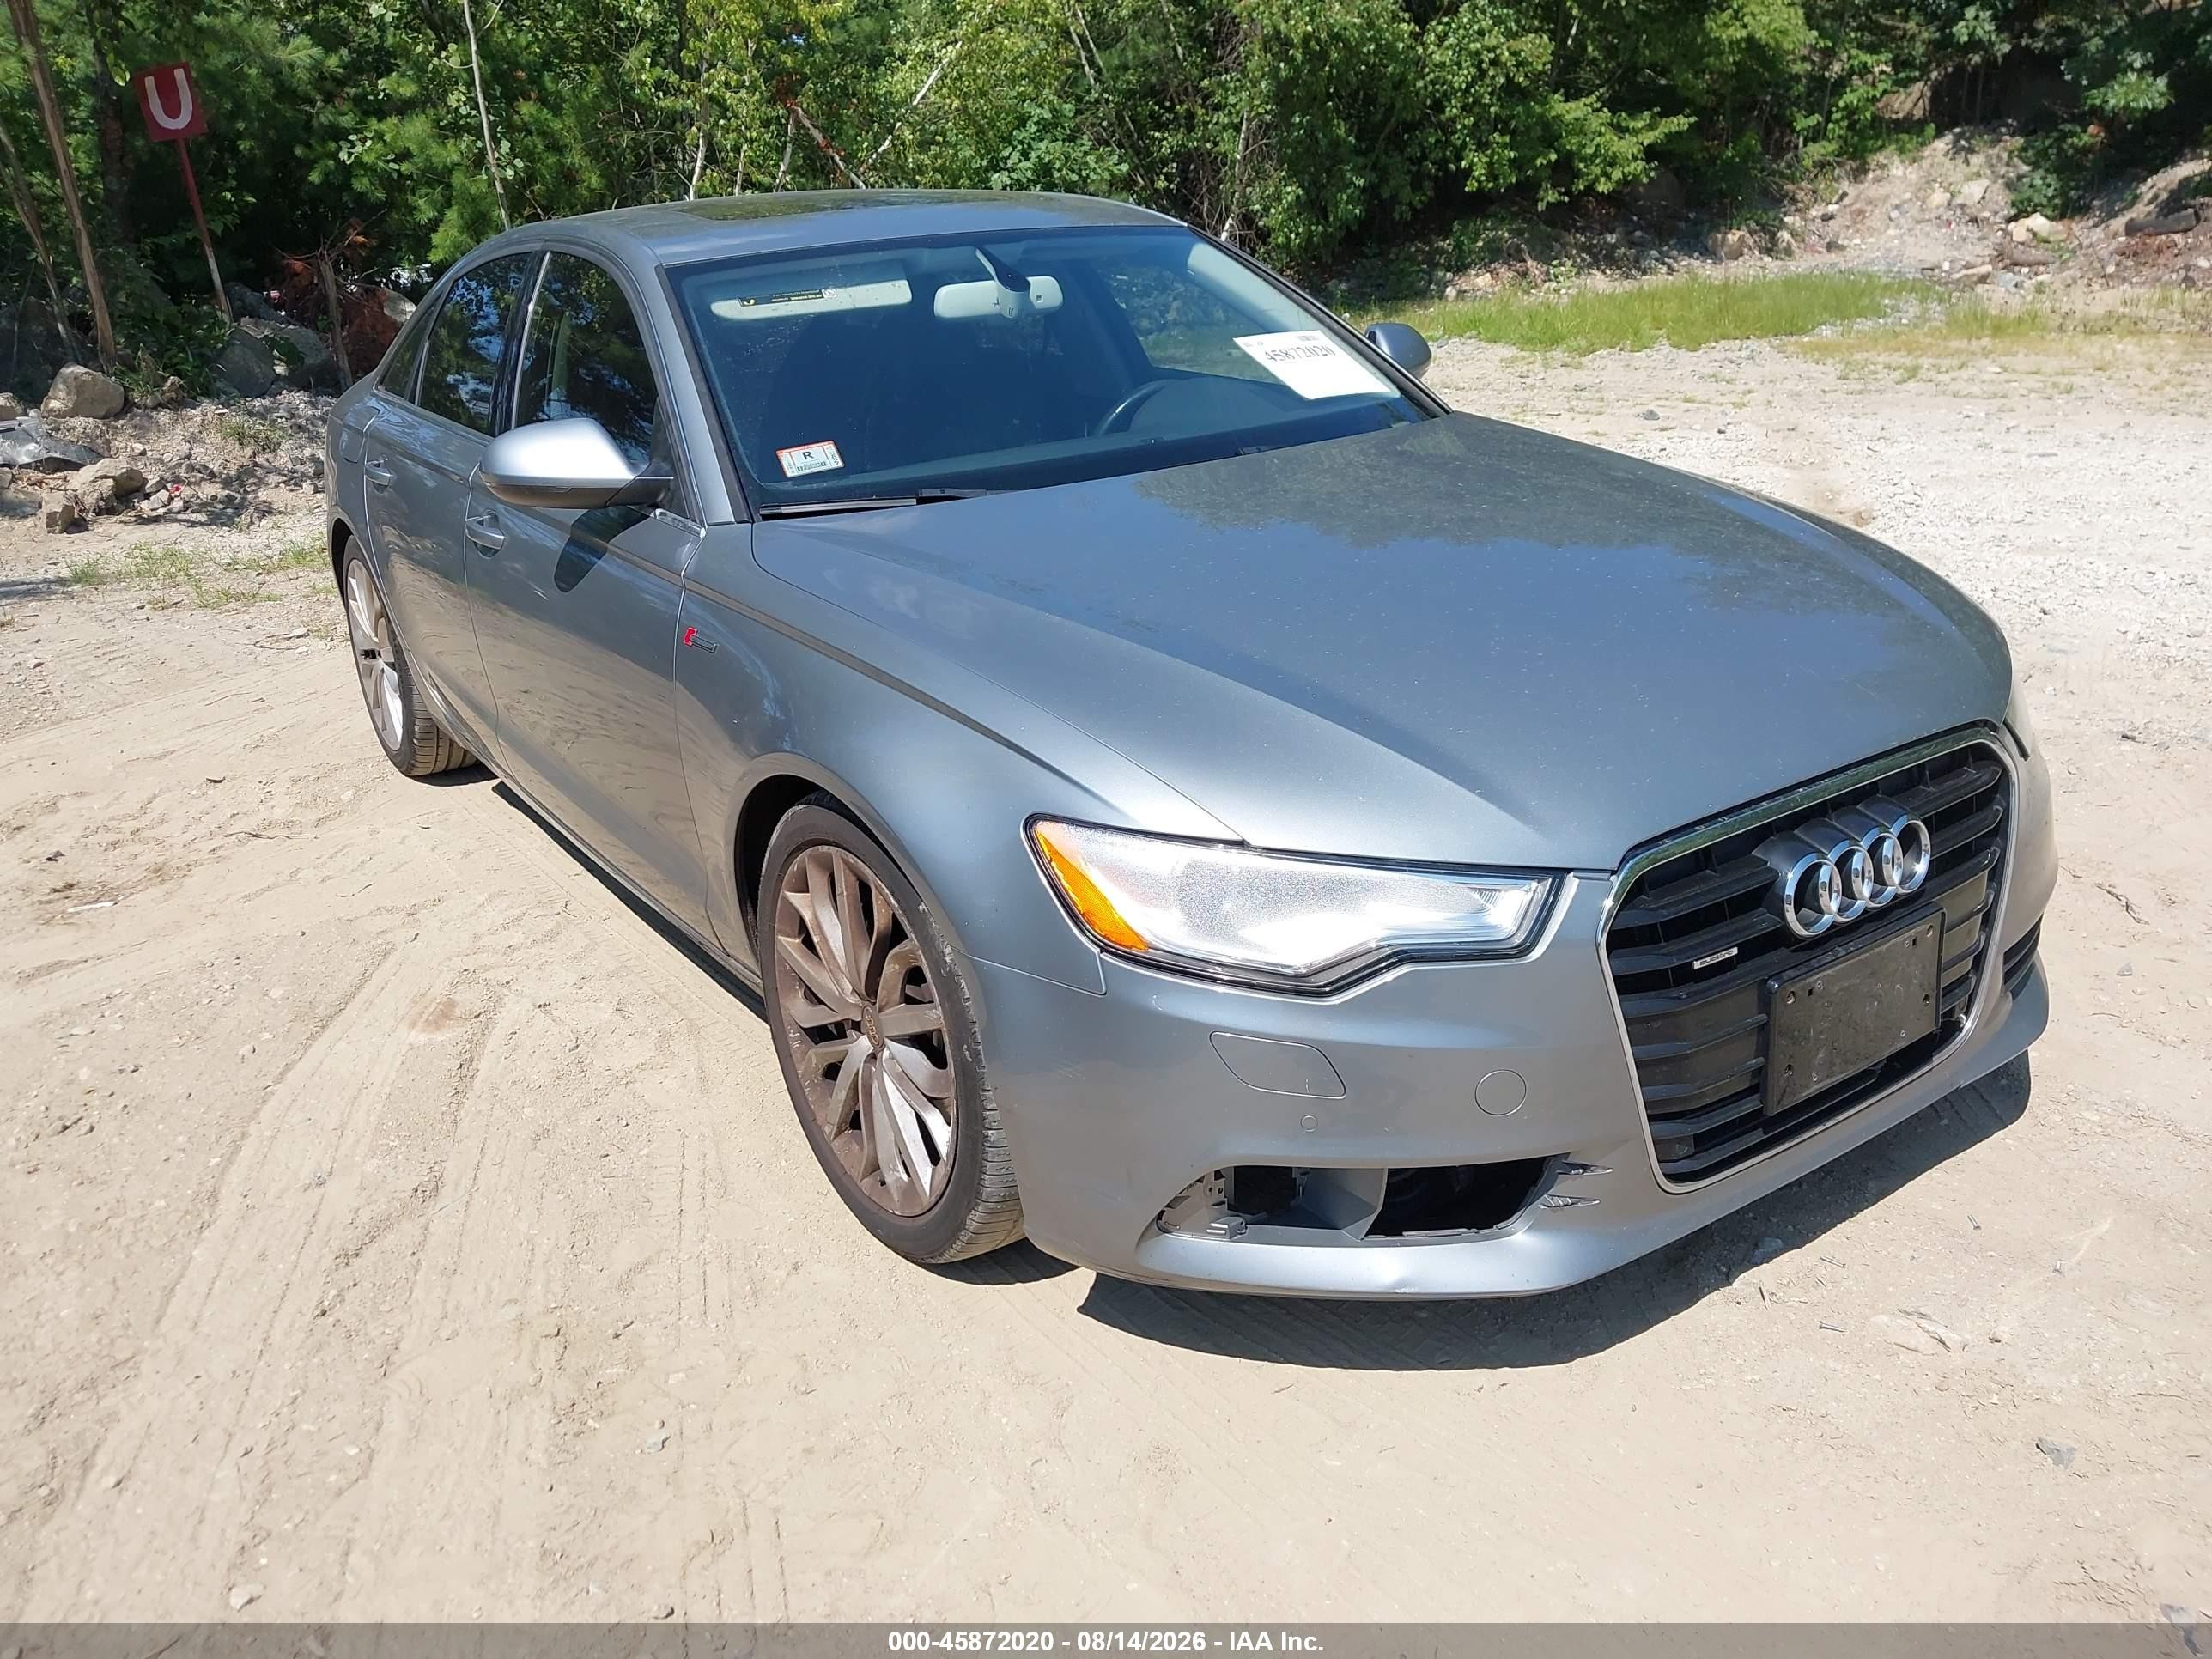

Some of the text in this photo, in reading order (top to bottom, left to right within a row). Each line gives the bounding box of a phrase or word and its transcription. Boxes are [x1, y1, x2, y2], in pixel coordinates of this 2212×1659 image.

[144, 68, 193, 130] U
[1265, 345, 1336, 362] 45872020
[802, 451, 815, 459] R
